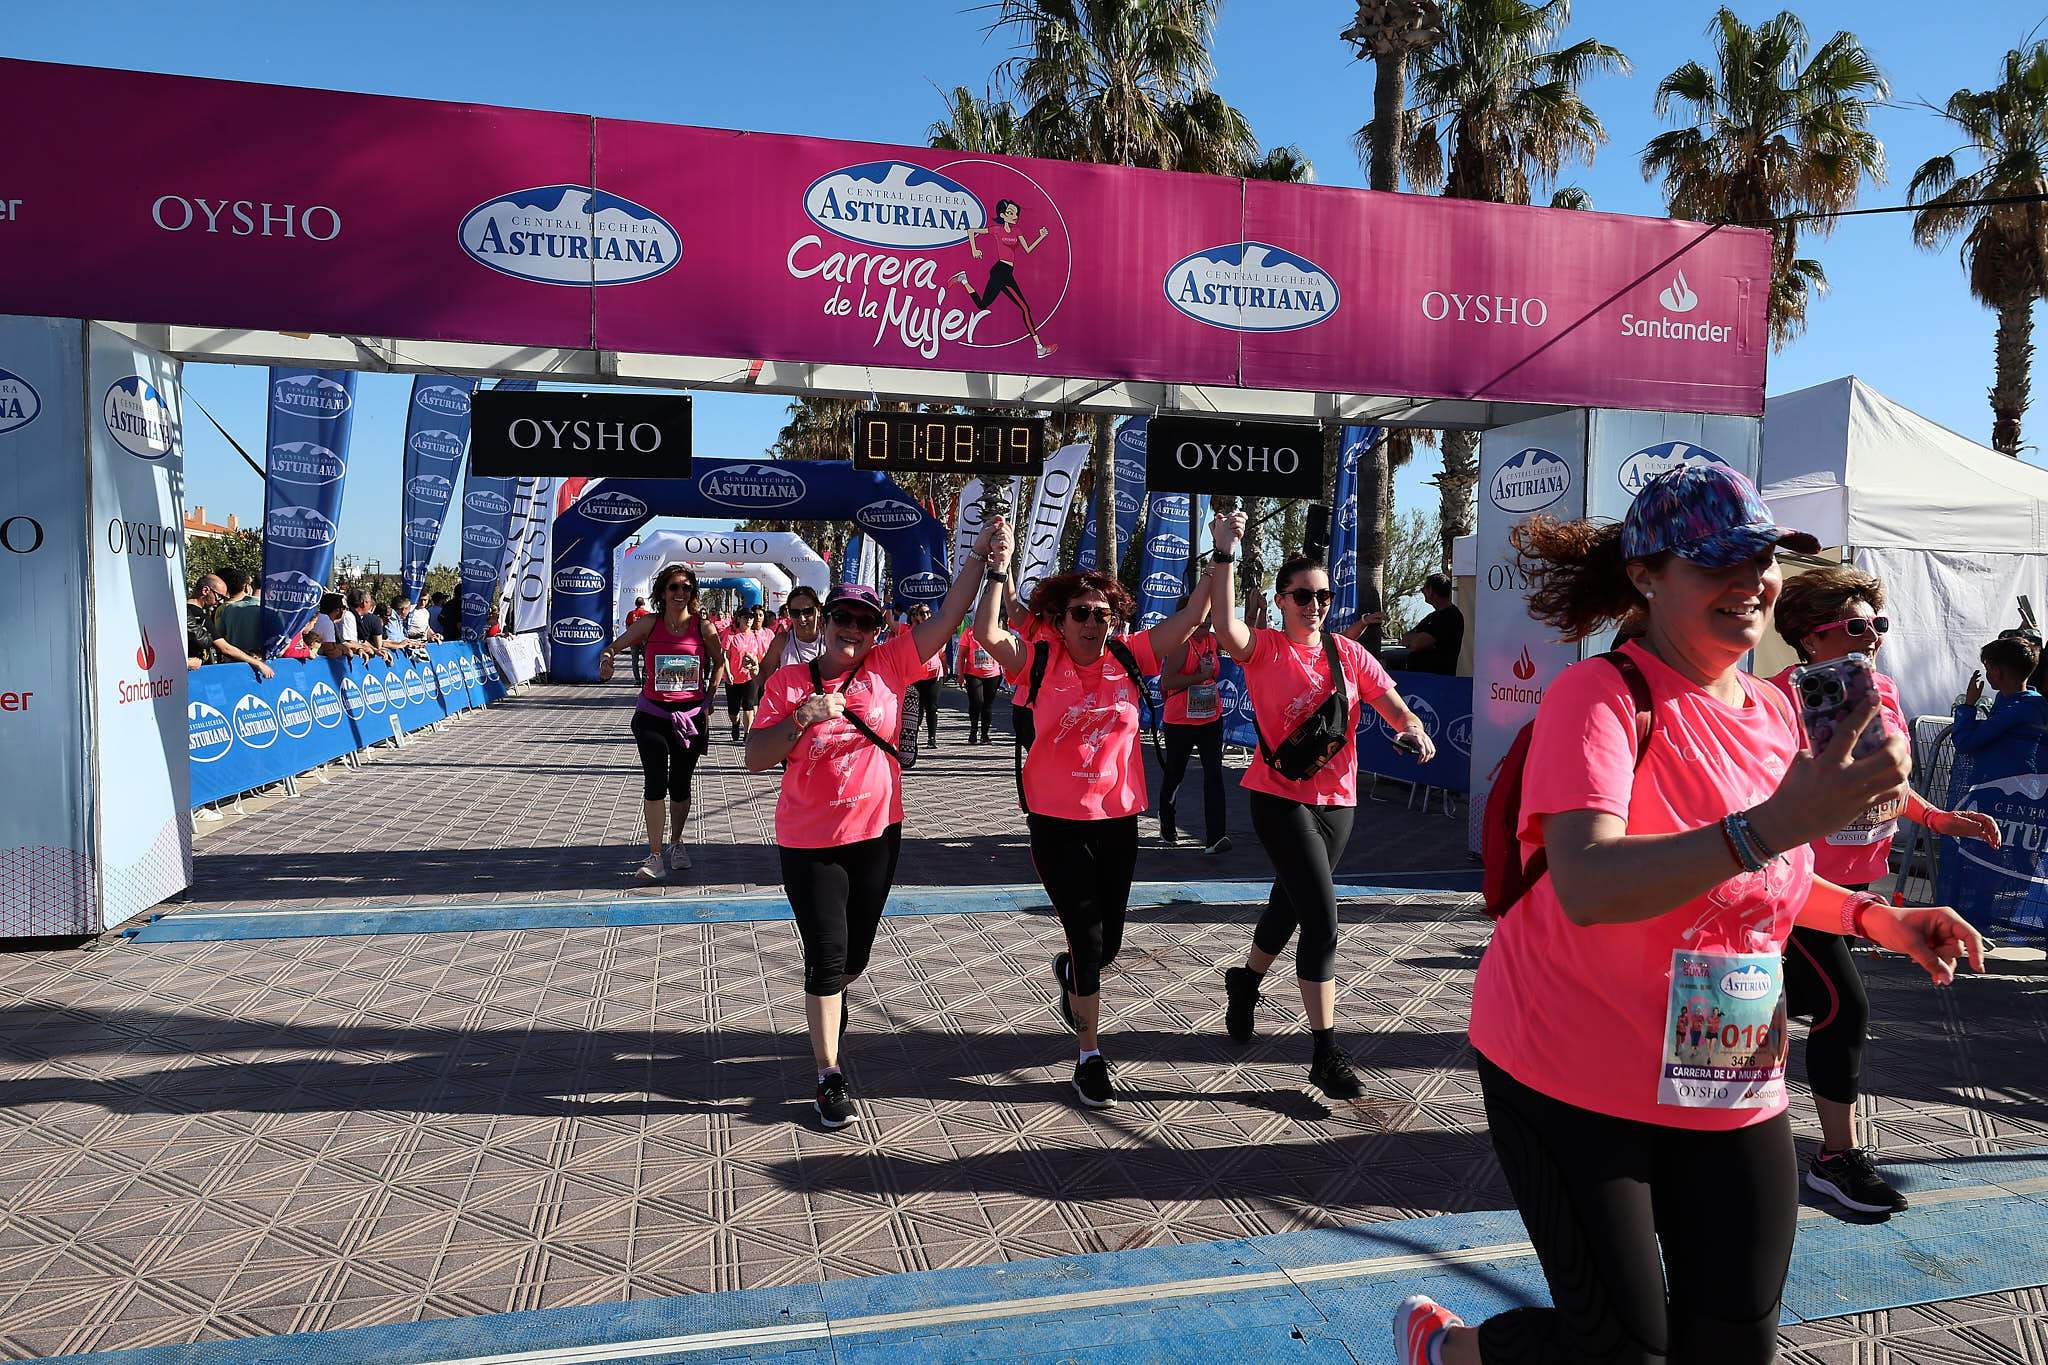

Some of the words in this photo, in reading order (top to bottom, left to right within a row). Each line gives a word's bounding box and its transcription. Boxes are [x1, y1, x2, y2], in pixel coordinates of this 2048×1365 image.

[846, 186, 906, 201] CENTRAL
[910, 192, 968, 206] LECHERA
[152, 195, 342, 242] OYSHO
[818, 186, 972, 232] ASTURIANA
[511, 215, 582, 231] CENTRAL
[476, 216, 666, 264] ASTURIANA
[787, 235, 937, 290] Carrera
[1205, 270, 1260, 282] CENTRAL
[1266, 274, 1322, 287] LECHERA
[1177, 270, 1327, 312] ASTURIANA
[1422, 291, 1548, 327] OYSHO
[824, 285, 852, 316] de
[858, 287, 878, 319] la
[873, 287, 992, 360] Mujer
[1621, 313, 1732, 343] Santander
[110, 396, 171, 445] ASTURIANA
[508, 417, 662, 454] OYSHO
[868, 421, 1030, 464] 01:08:19
[1176, 441, 1300, 475] OYSHO
[1505, 469, 1533, 481] CENTRAL
[706, 476, 799, 498] ASTURIANA
[1494, 474, 1564, 501] ASTURIANA
[582, 502, 642, 516] ASTURIANA
[862, 511, 918, 523] ASTURIANA
[108, 518, 177, 559] OYSHO
[685, 536, 768, 555] OYSHO
[555, 577, 602, 589] ASTURIANA
[553, 626, 601, 639] ASTURIANA
[118, 675, 174, 705] Santander
[1491, 682, 1546, 705] Santand
[238, 716, 277, 738] ASTURIANA
[281, 708, 311, 728] ASTURIANA
[1836, 833, 1867, 841] OYSHO
[1731, 1055, 1756, 1067] 3476
[1672, 1066, 1712, 1078] CARRERA
[1713, 1069, 1725, 1079] DE
[1726, 1069, 1737, 1079] LA
[1738, 1070, 1762, 1079] MUJER
[1680, 1084, 1728, 1099] OYSHO
